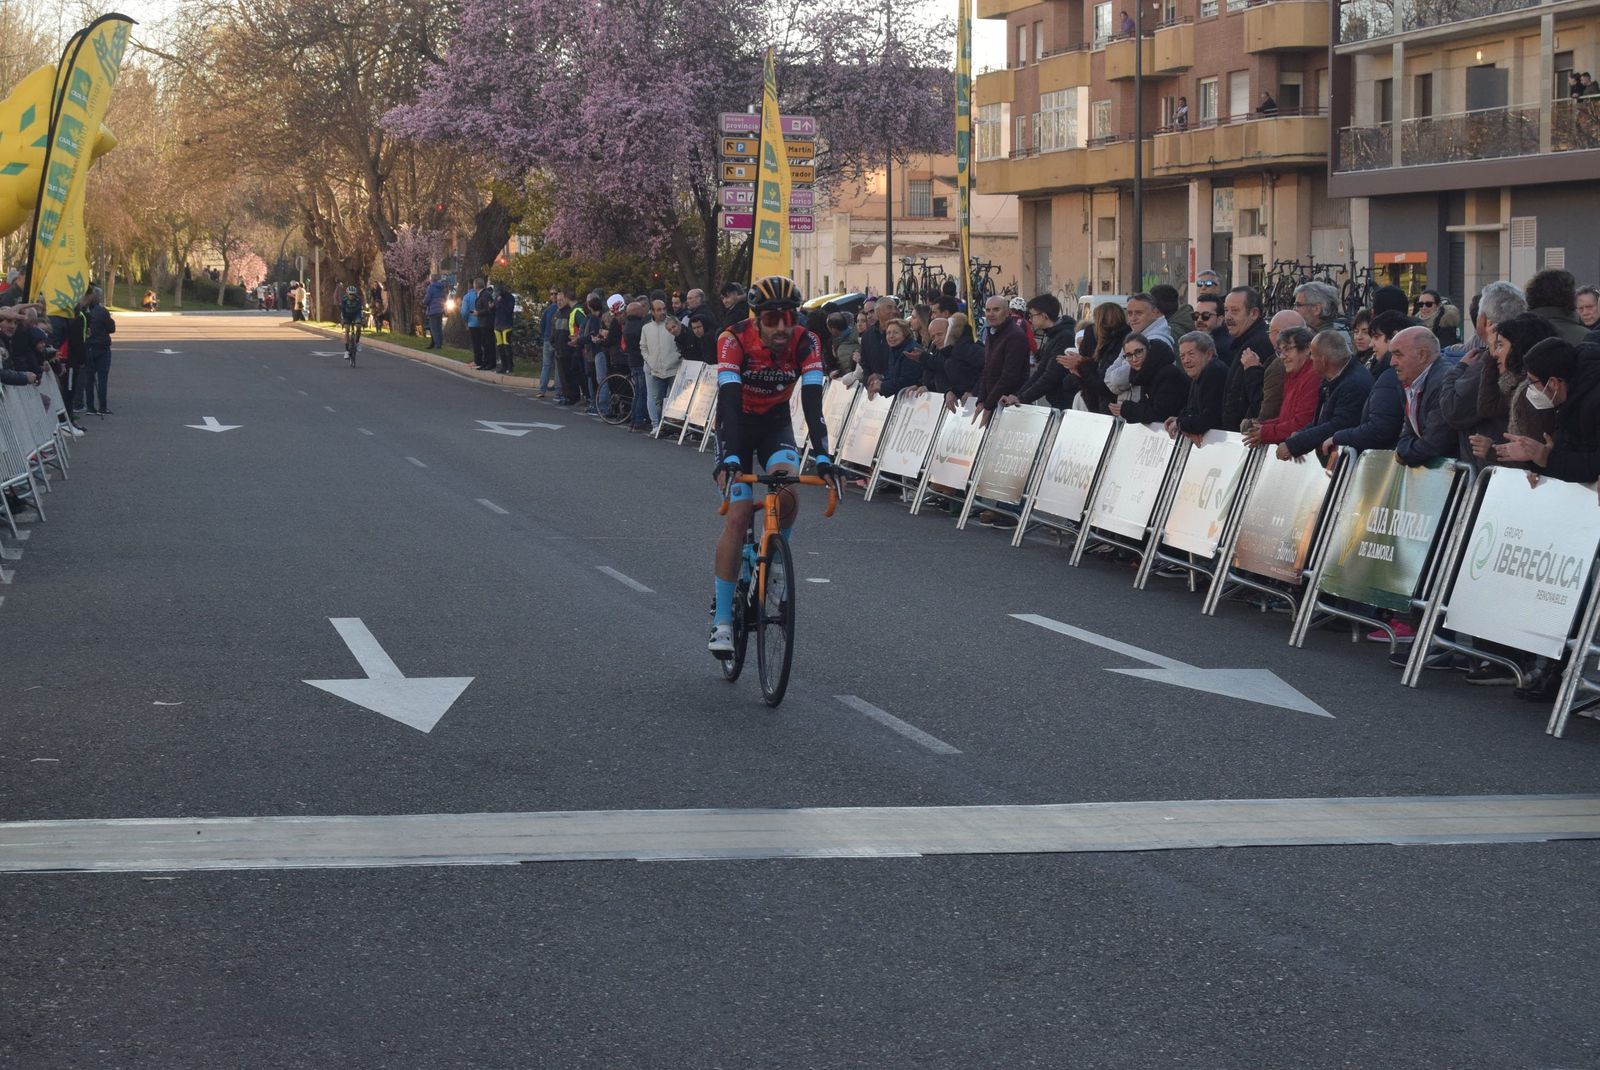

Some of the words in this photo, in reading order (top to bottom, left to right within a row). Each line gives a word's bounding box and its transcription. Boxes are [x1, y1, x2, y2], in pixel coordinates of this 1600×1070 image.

[1366, 506, 1389, 535] CAJA
[1388, 509, 1433, 542] RURAL
[1503, 526, 1524, 540] GRUPO
[1358, 541, 1369, 556] DE
[1367, 542, 1394, 561] ZAMORA
[1493, 543, 1584, 590] IBEREÓLICA
